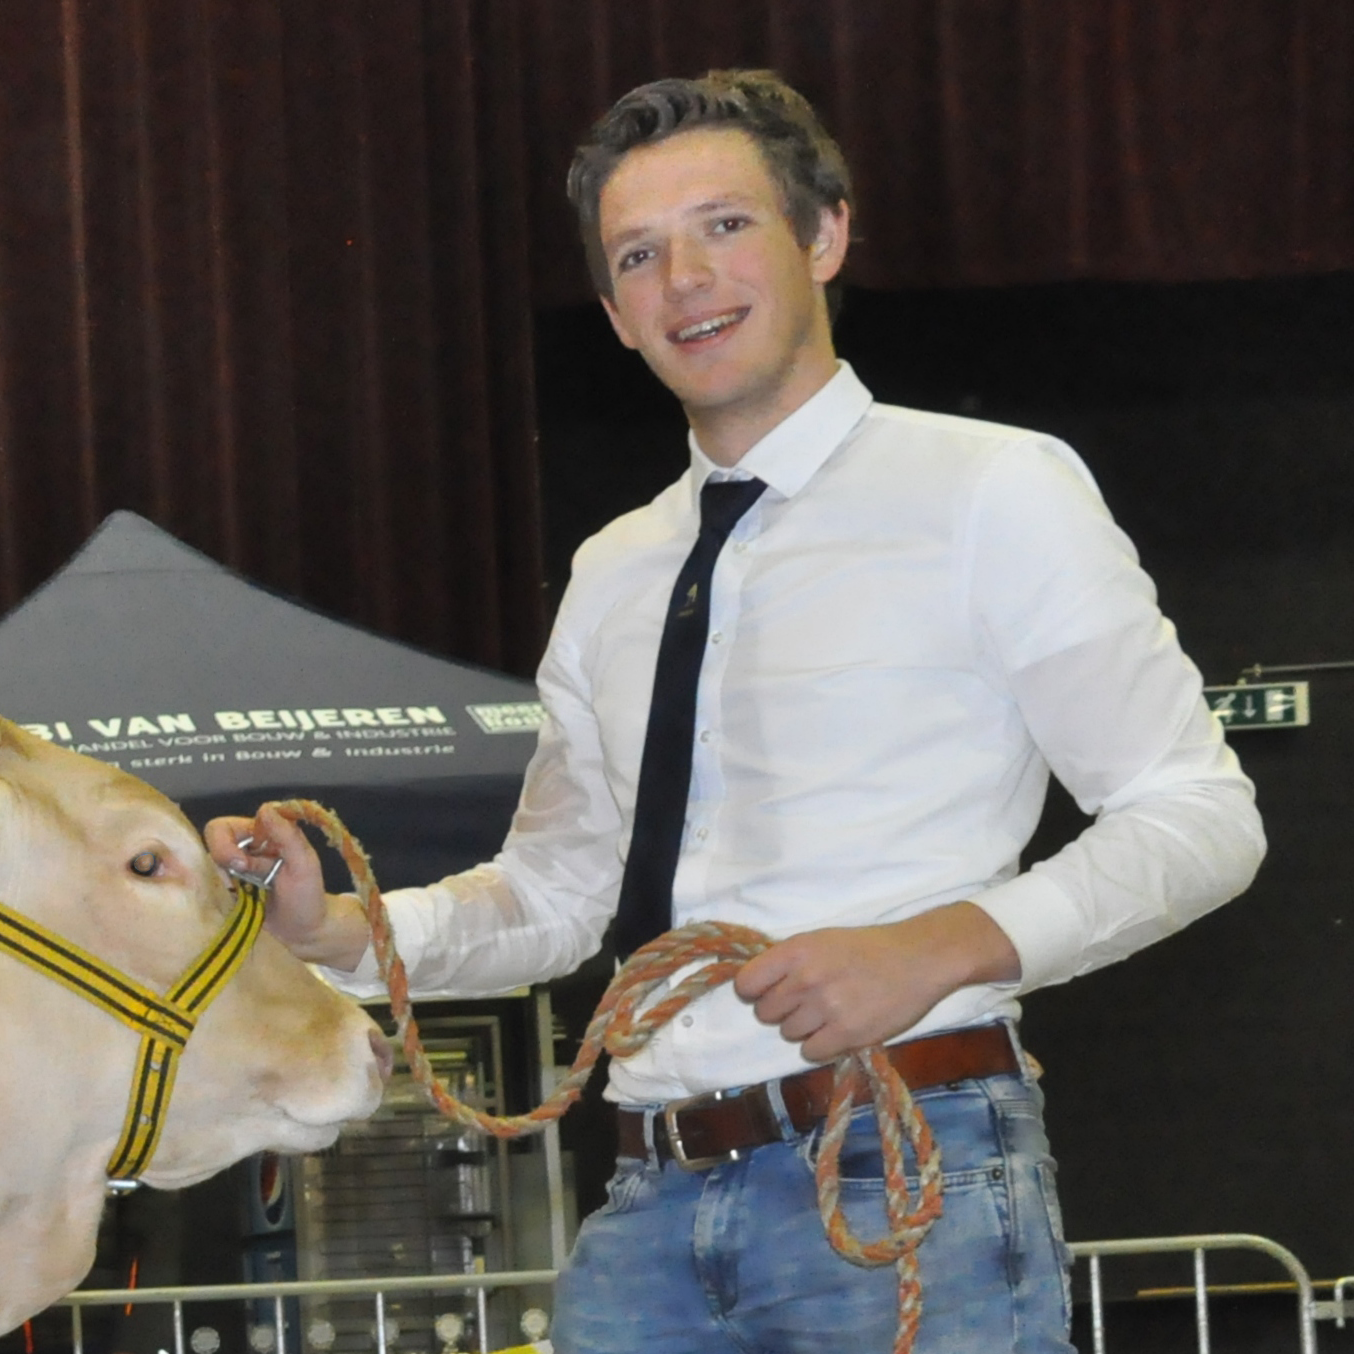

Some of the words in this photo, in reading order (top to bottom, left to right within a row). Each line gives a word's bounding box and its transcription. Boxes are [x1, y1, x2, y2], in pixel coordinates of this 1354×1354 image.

[88, 713, 197, 738] VAN
[214, 706, 447, 732] BEIJEREN
[157, 733, 227, 747] VOOR
[232, 731, 306, 743] BOUW
[335, 726, 457, 740] INDUSTRIE
[130, 754, 193, 769] sterk
[202, 751, 226, 763] in
[235, 749, 303, 761] Bouw
